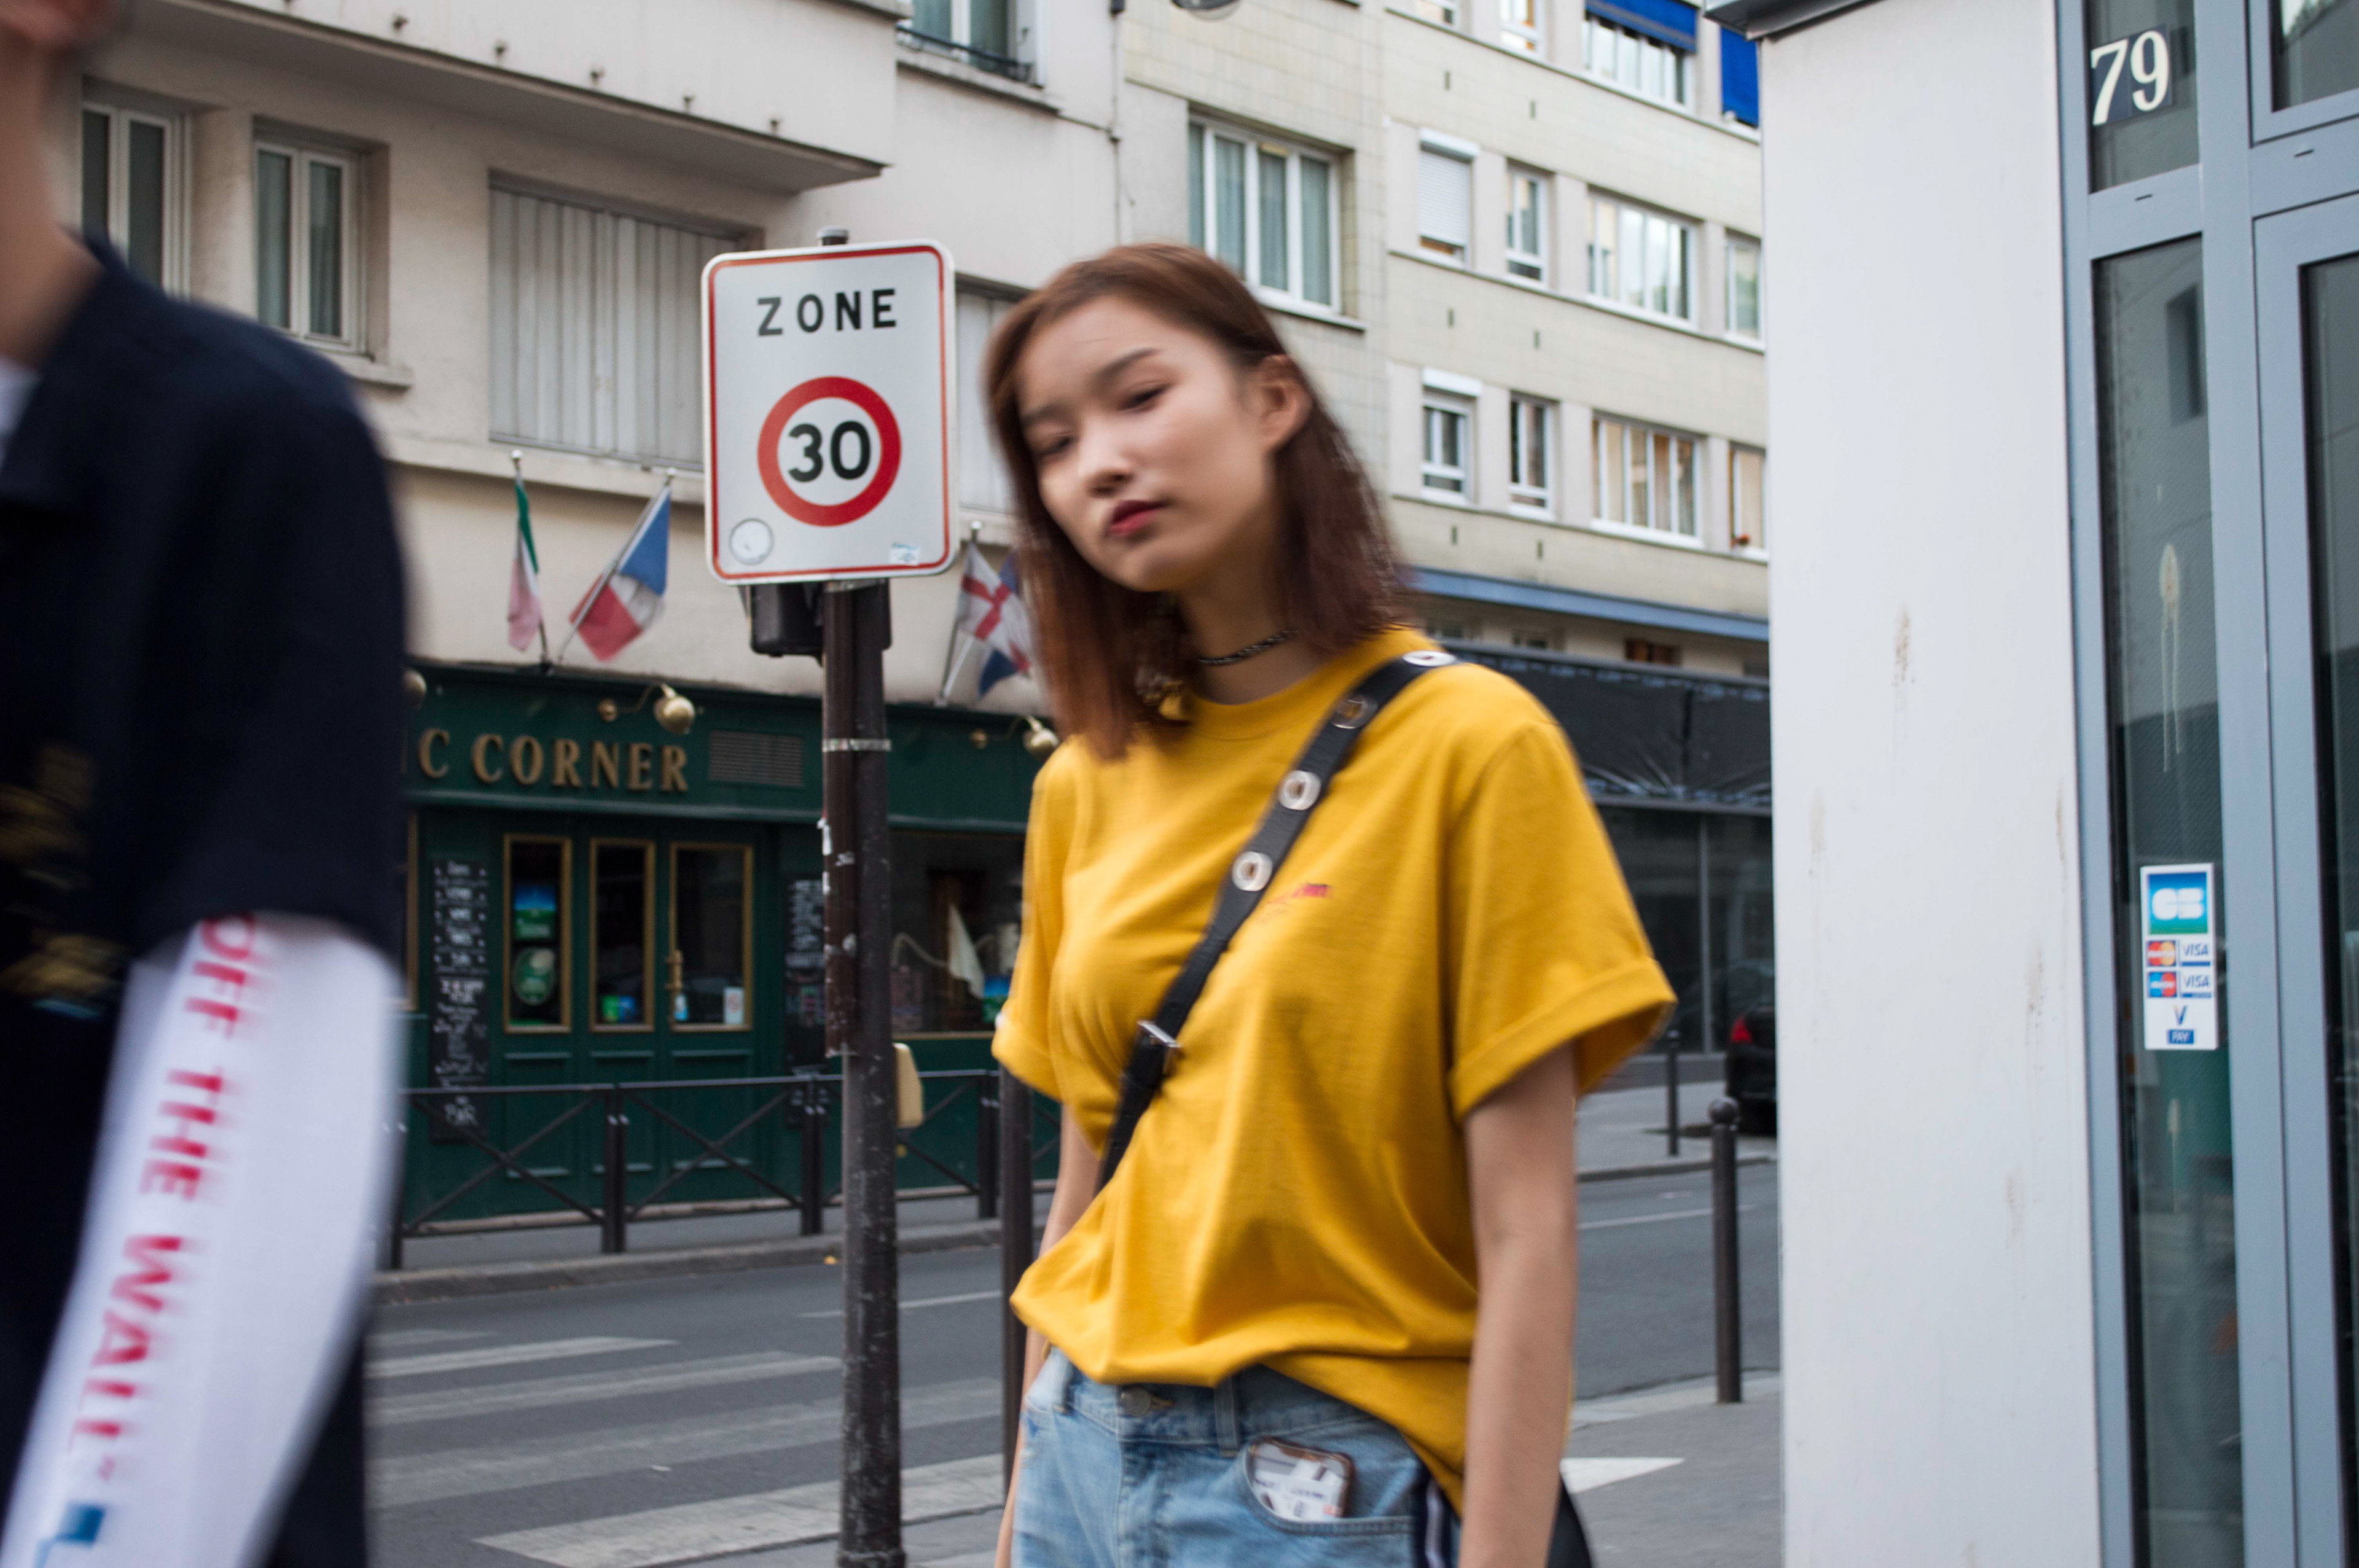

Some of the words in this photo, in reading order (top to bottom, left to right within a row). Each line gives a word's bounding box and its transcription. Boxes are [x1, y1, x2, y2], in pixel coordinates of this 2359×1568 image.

[2090, 30, 2169, 127] 79
[757, 288, 897, 336] ZONE
[788, 420, 872, 483] 30
[471, 733, 689, 793] CORNER
[185, 911, 256, 1040] OFF
[2183, 943, 2208, 956] VISA
[2184, 975, 2210, 988] VISA
[2172, 1005, 2188, 1026] V
[139, 1065, 223, 1201] THE
